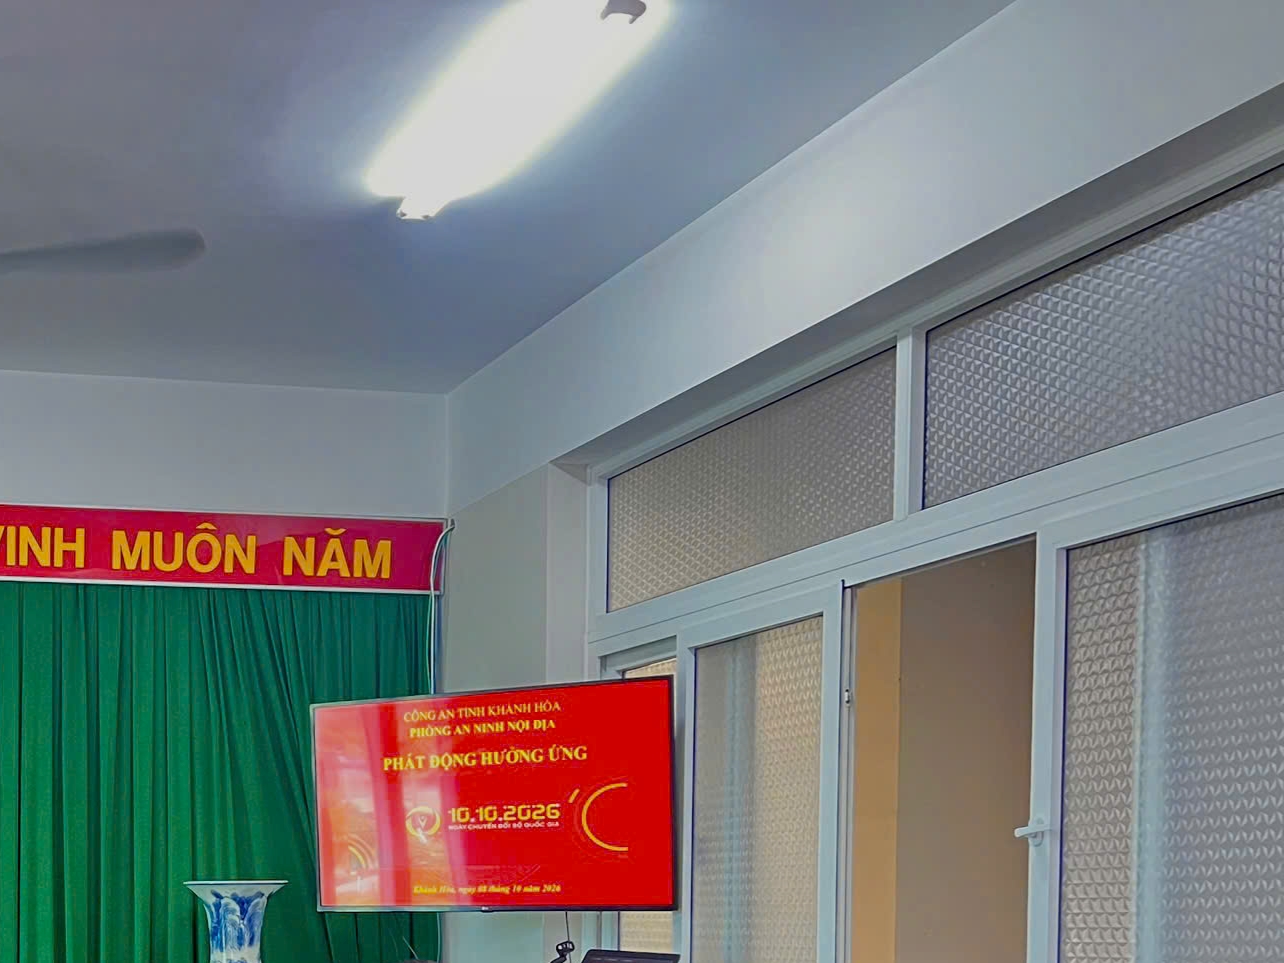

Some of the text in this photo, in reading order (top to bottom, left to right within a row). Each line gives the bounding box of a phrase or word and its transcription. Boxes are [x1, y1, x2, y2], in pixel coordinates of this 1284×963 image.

[111, 522, 257, 574] MUÔN
[282, 527, 392, 579] NĂM
[403, 709, 436, 722] CÔNG
[438, 709, 455, 720] AN
[454, 723, 471, 735] AN
[473, 721, 505, 734] NINH
[383, 752, 426, 771] PHÁT
[429, 752, 477, 771] ĐỘNG
[548, 744, 588, 761] ỨNG
[448, 804, 561, 823] 10.10.2026
